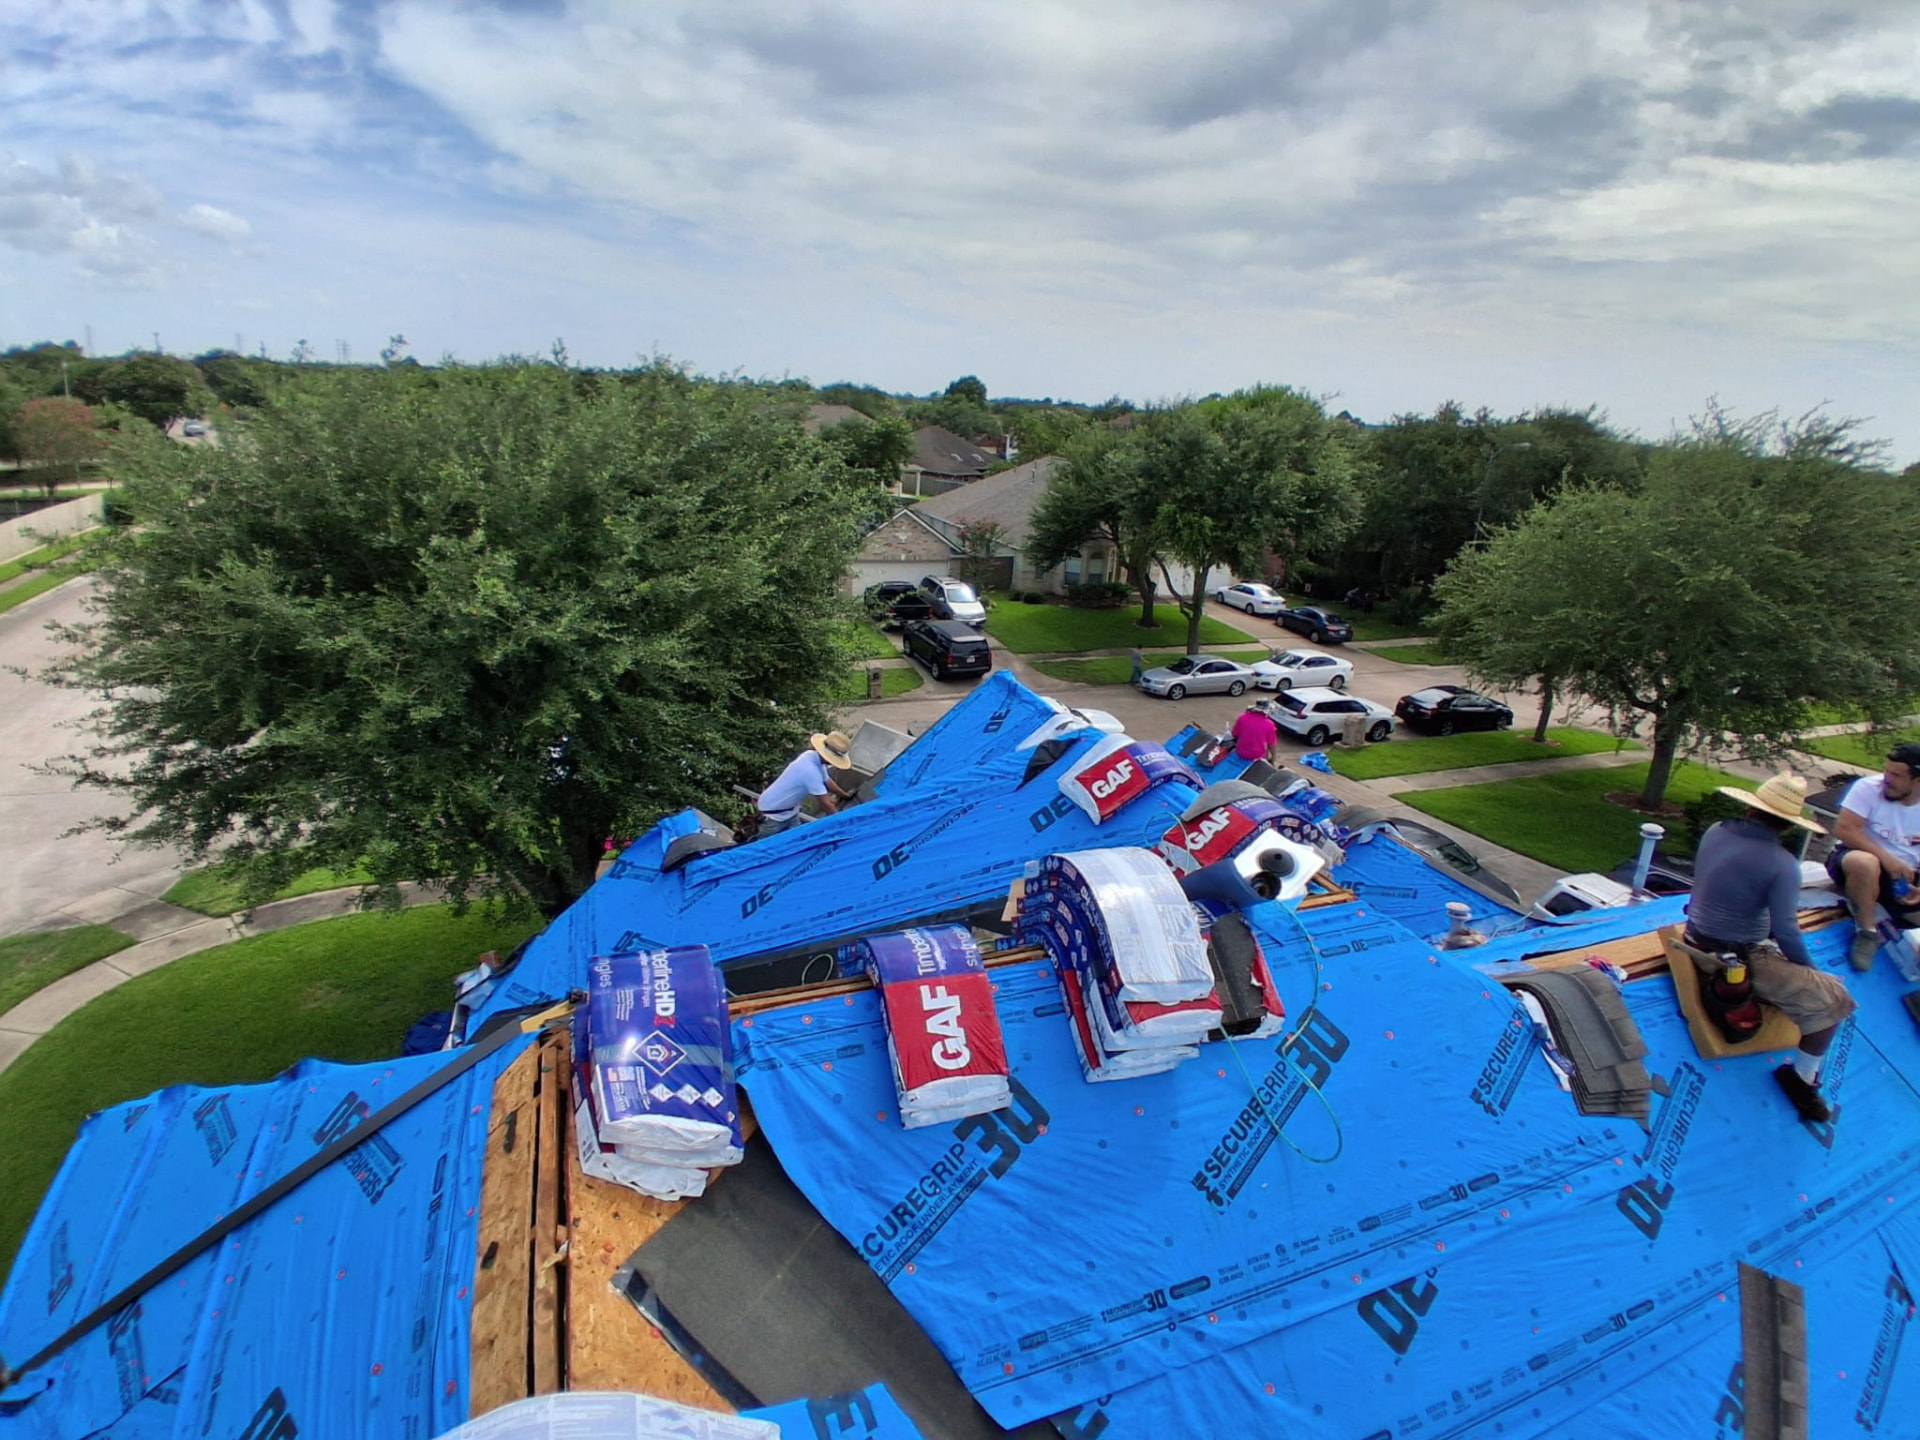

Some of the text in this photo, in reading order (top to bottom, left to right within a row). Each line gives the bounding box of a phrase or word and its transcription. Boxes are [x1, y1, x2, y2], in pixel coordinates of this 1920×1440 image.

[1091, 759, 1136, 799] GAF
[870, 842, 911, 882] 30
[1185, 806, 1232, 850] GAF
[741, 884, 774, 920] 30
[652, 950, 676, 1026] berlineHDZ
[919, 985, 971, 1070] GAF
[1201, 1058, 1294, 1181] SECUREGRIP
[1274, 1003, 1353, 1091] 30
[1217, 1147, 1251, 1190] SYNTHETIC
[1246, 1127, 1265, 1149] ROOF
[1658, 1080, 1704, 1181] SECUREGRIP
[853, 1073, 1055, 1266] CUREGRIP 30
[893, 1223, 921, 1252] ROOF
[916, 1158, 981, 1227] UNDERLAYMENT
[1143, 1289, 1168, 1313] 30
[1858, 1303, 1897, 1413] SECUREGRIP
